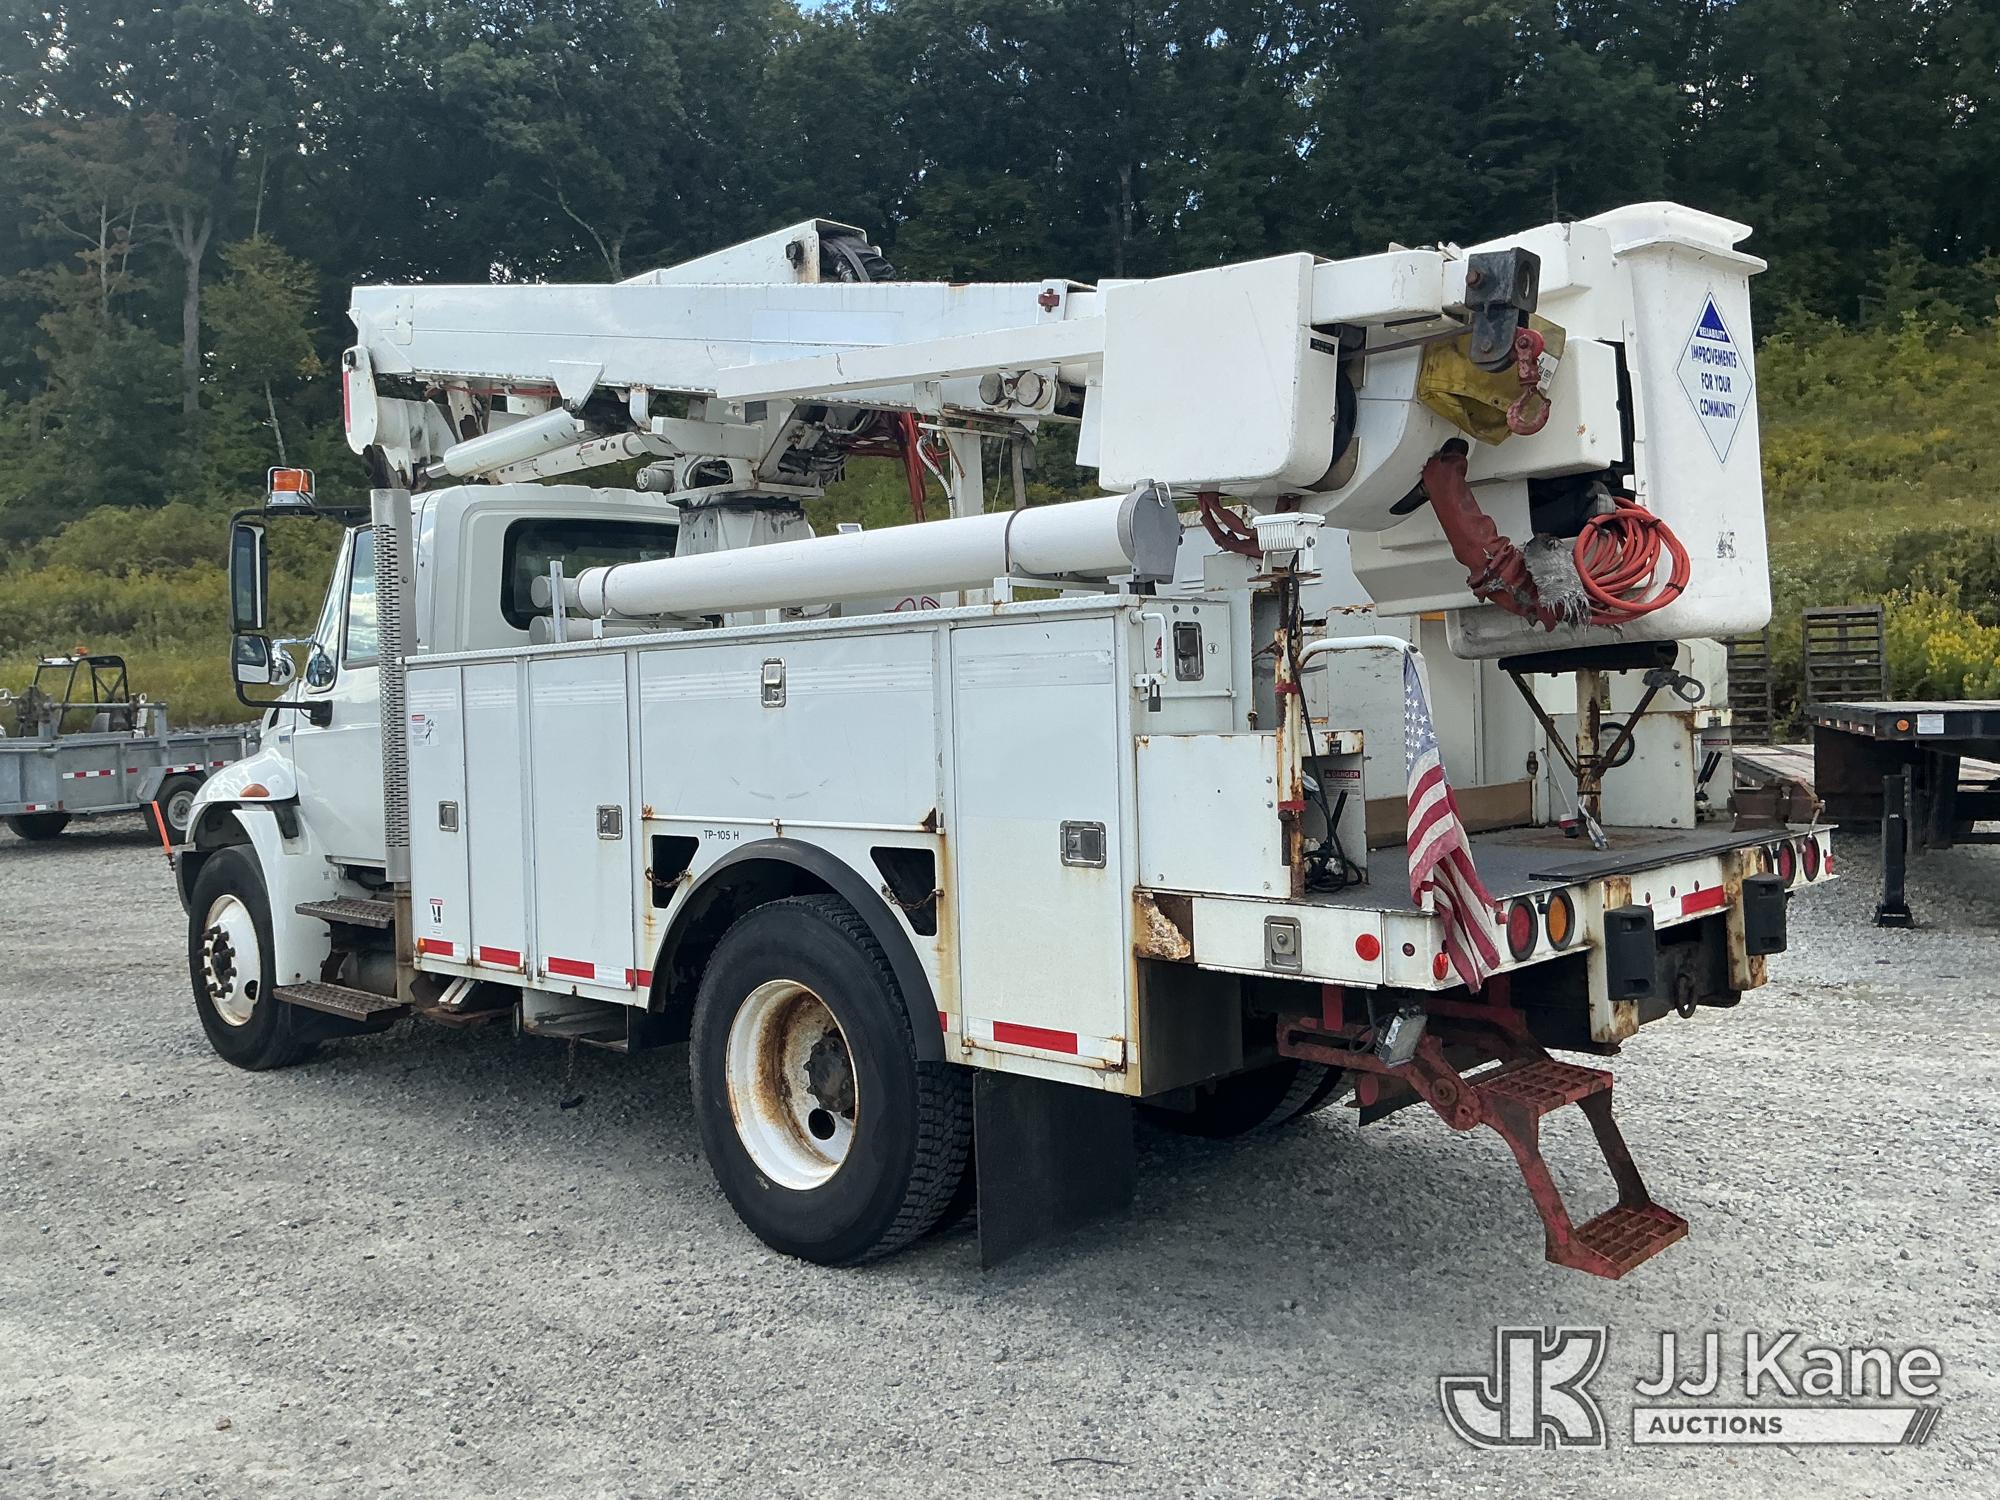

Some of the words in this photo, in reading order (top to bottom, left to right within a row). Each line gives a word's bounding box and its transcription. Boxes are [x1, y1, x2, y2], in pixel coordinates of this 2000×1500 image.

[1699, 327, 1726, 341] RELIABILITY
[1691, 344, 1737, 368] IMPROVEMENTS
[1701, 372, 1713, 390] FOR
[1714, 374, 1732, 393] YOUR
[1700, 398, 1736, 419] COMMUNITY
[704, 830, 730, 840] TP-105
[733, 830, 740, 840] H
